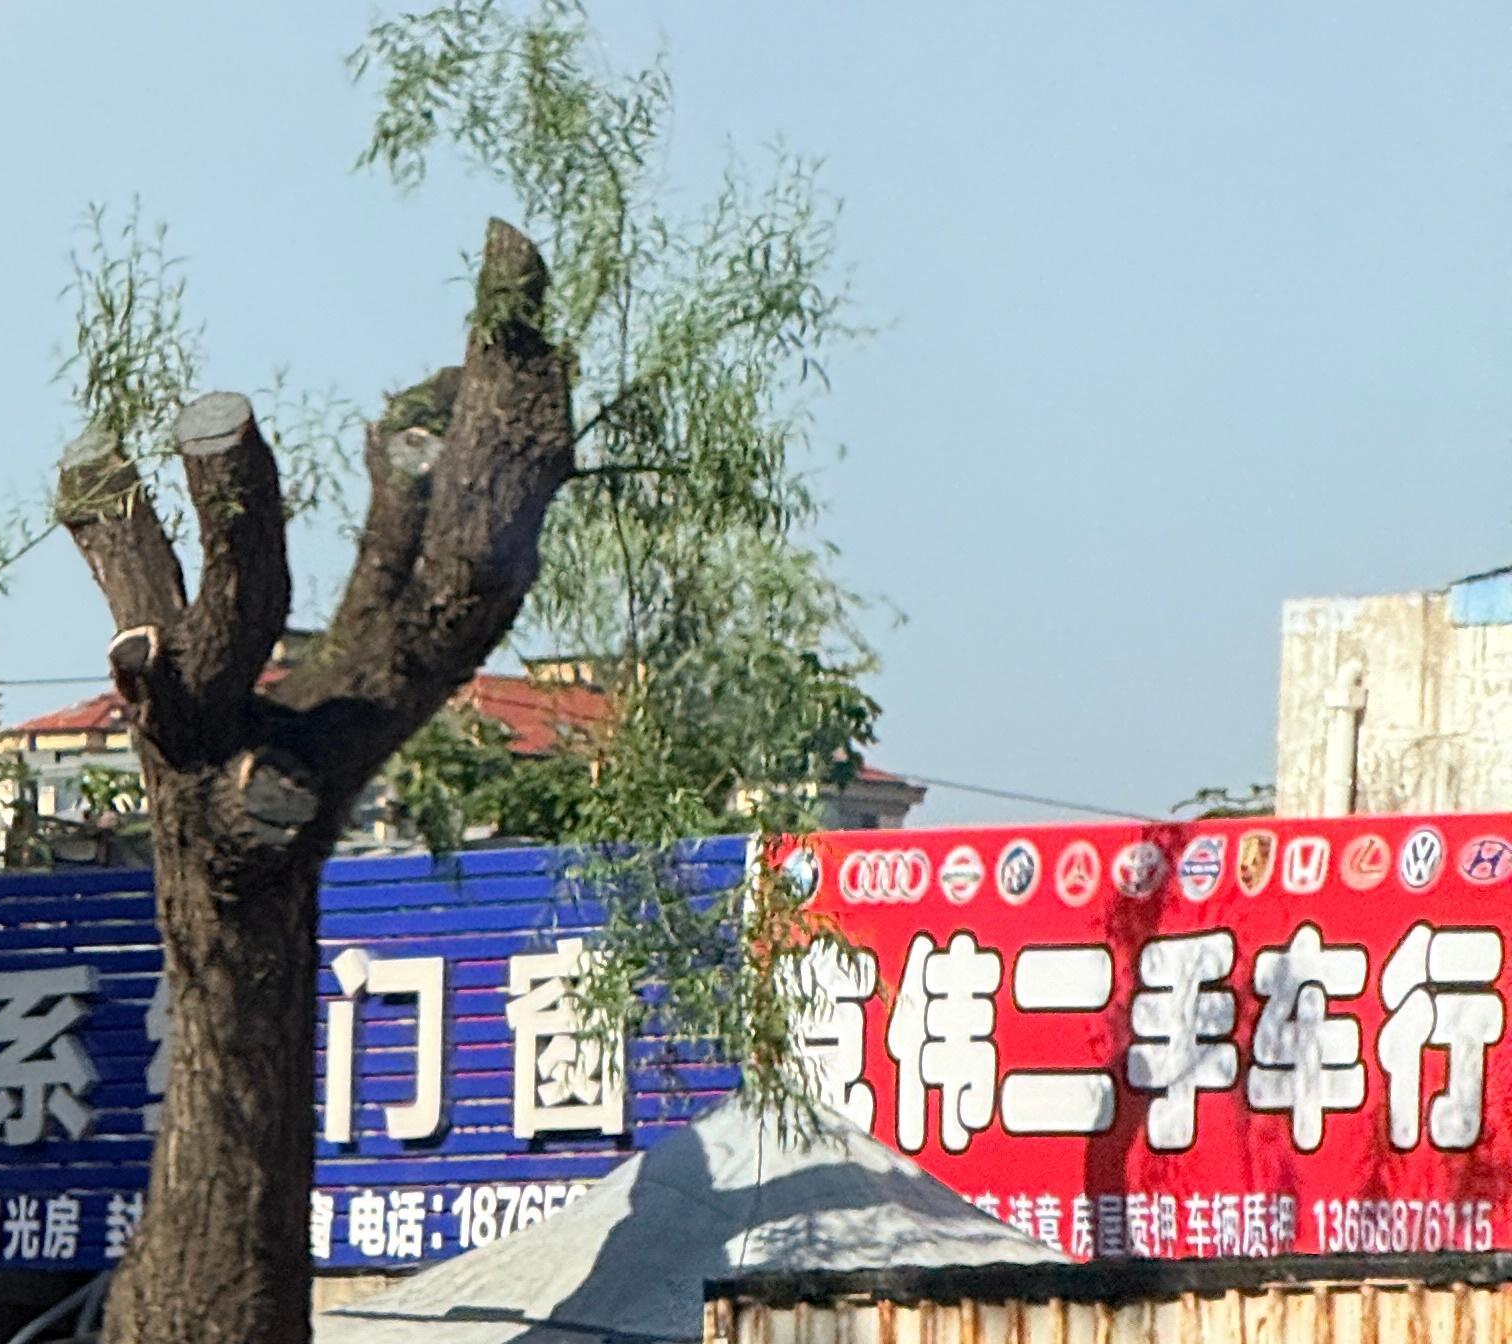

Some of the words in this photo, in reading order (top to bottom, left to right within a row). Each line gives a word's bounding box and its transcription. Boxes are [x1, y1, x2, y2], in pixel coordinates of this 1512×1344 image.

[1071, 1192, 1177, 1258] 房屋质押
[1184, 1192, 1297, 1258] 车辆质押
